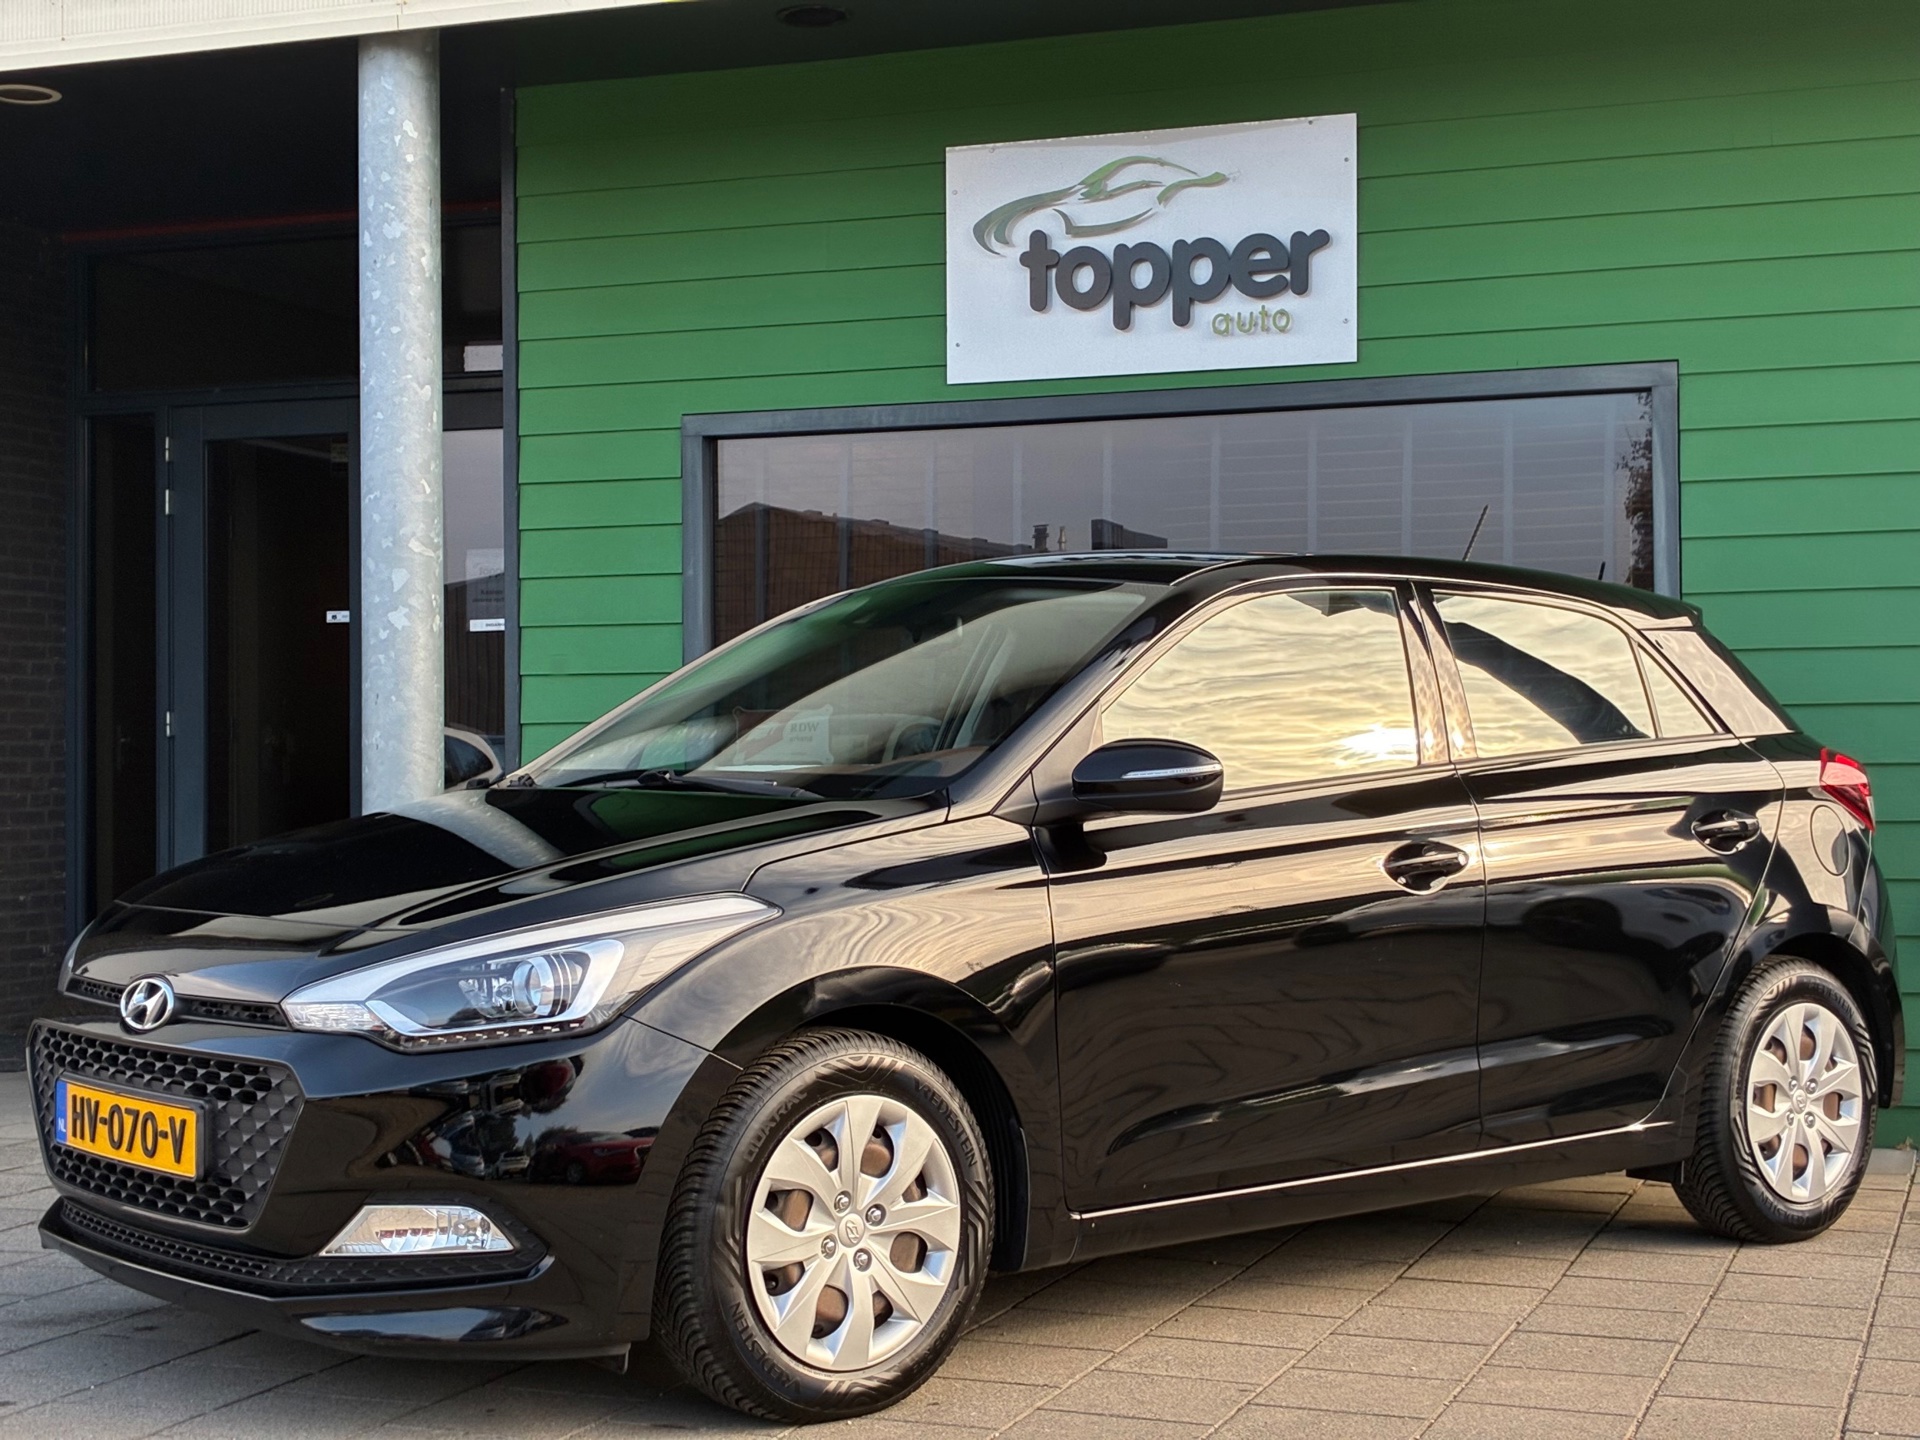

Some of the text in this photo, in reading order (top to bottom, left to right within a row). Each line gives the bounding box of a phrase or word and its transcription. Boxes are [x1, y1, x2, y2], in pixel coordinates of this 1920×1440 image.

[1019, 229, 1331, 331] topper
[1211, 304, 1292, 336] auto
[790, 721, 820, 733] RDW
[58, 1117, 67, 1132] NL
[71, 1093, 187, 1165] HV-070-V
[913, 1075, 978, 1168] VREDESTEIN
[729, 1301, 801, 1395] VREDESTEIN
